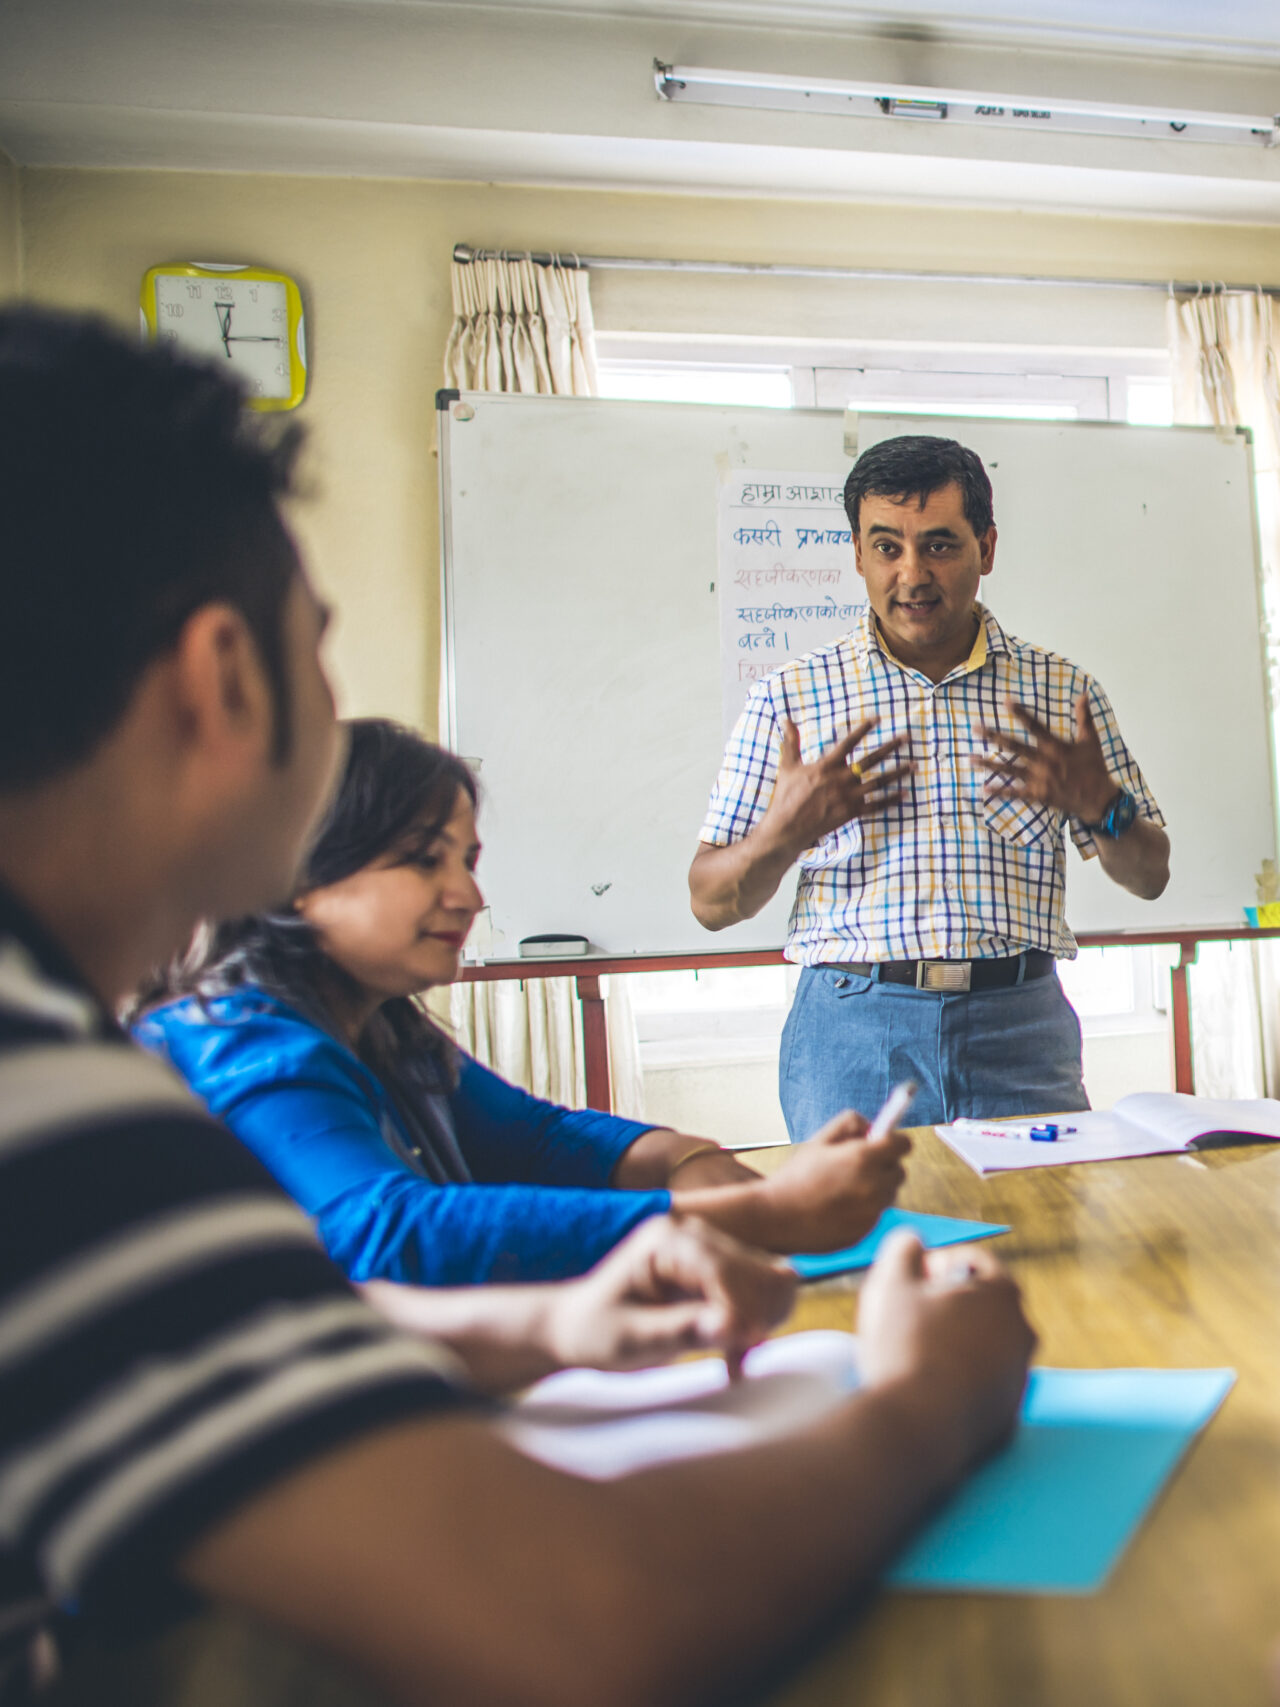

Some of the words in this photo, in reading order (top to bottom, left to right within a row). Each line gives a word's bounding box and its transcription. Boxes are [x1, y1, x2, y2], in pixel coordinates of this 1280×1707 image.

[187, 285, 202, 299] 11
[214, 286, 233, 300] 12
[249, 288, 258, 302] 1
[165, 303, 184, 318] 10
[272, 308, 282, 322] 2
[741, 483, 782, 505] हाम्रा
[733, 519, 782, 547] कसरी
